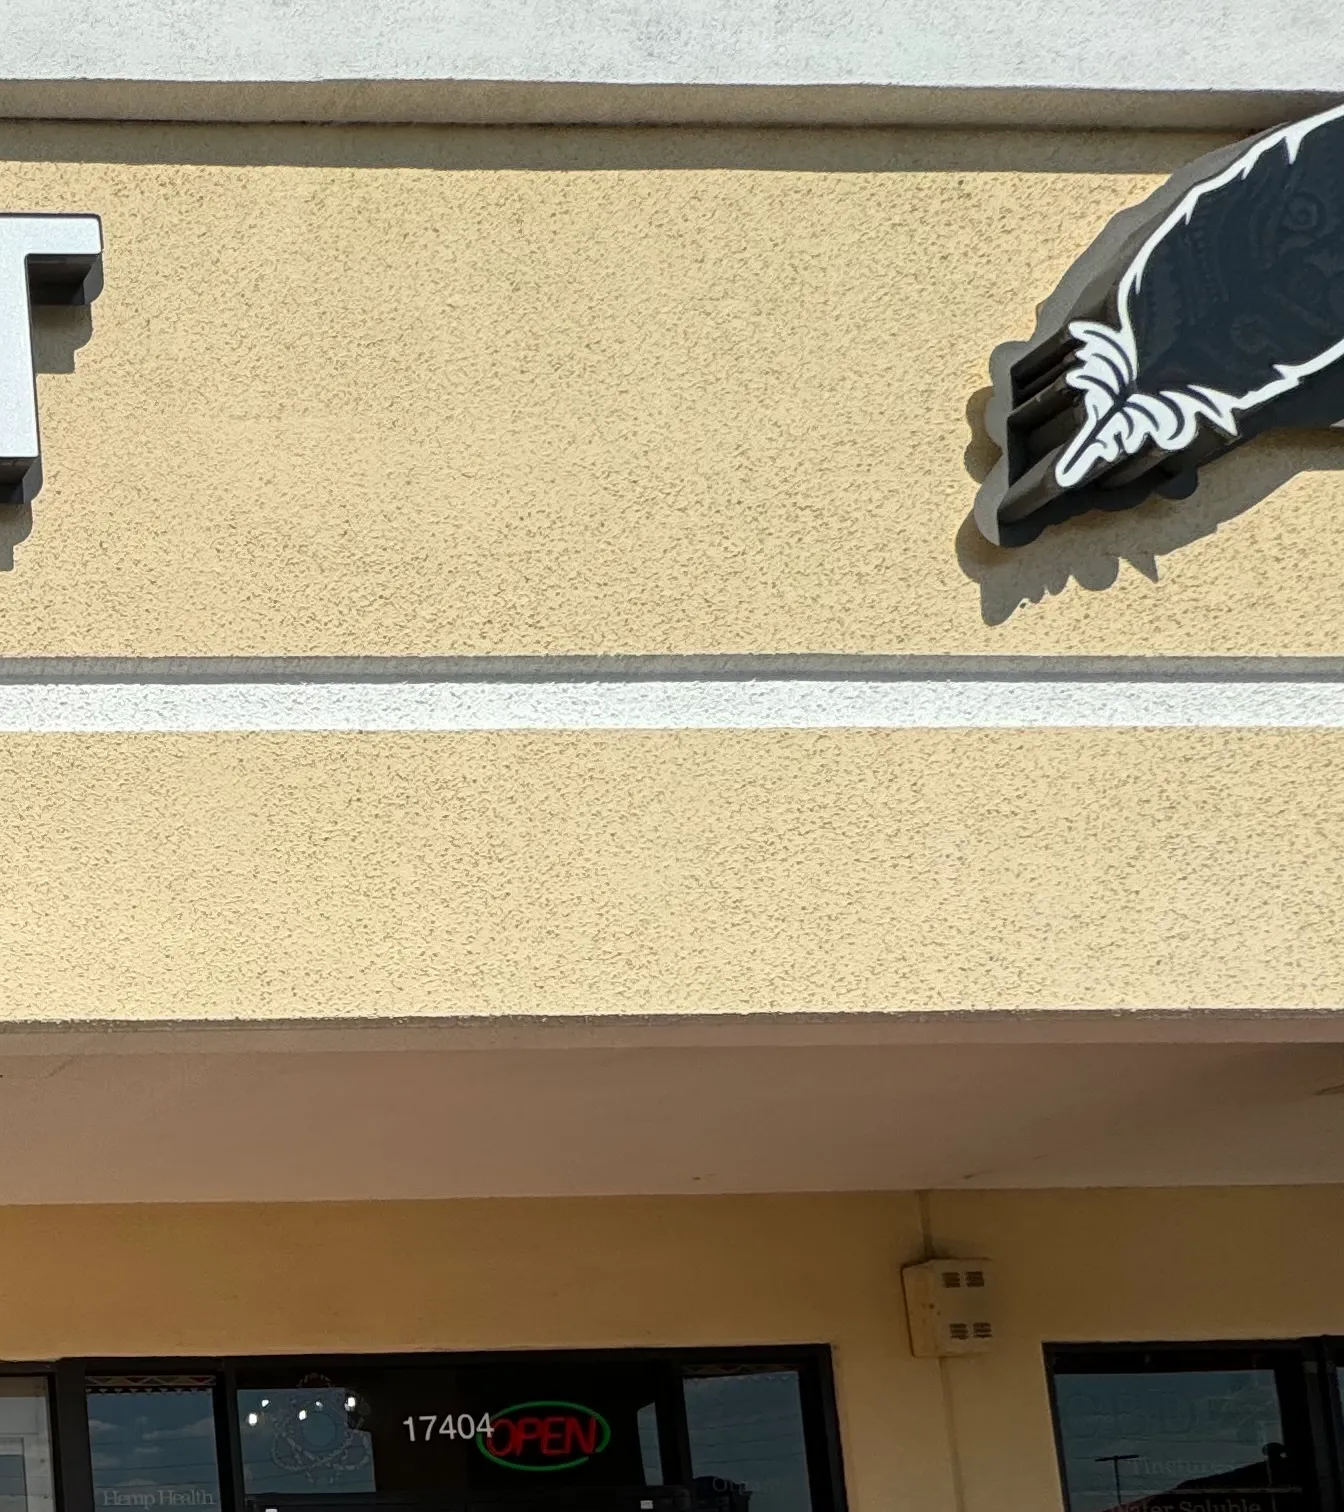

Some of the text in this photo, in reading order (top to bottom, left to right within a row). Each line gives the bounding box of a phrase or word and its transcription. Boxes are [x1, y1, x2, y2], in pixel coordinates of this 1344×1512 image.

[403, 1412, 495, 1442] 17404
[486, 1416, 597, 1457] OPEN
[103, 1488, 214, 1510] Hemp Health
